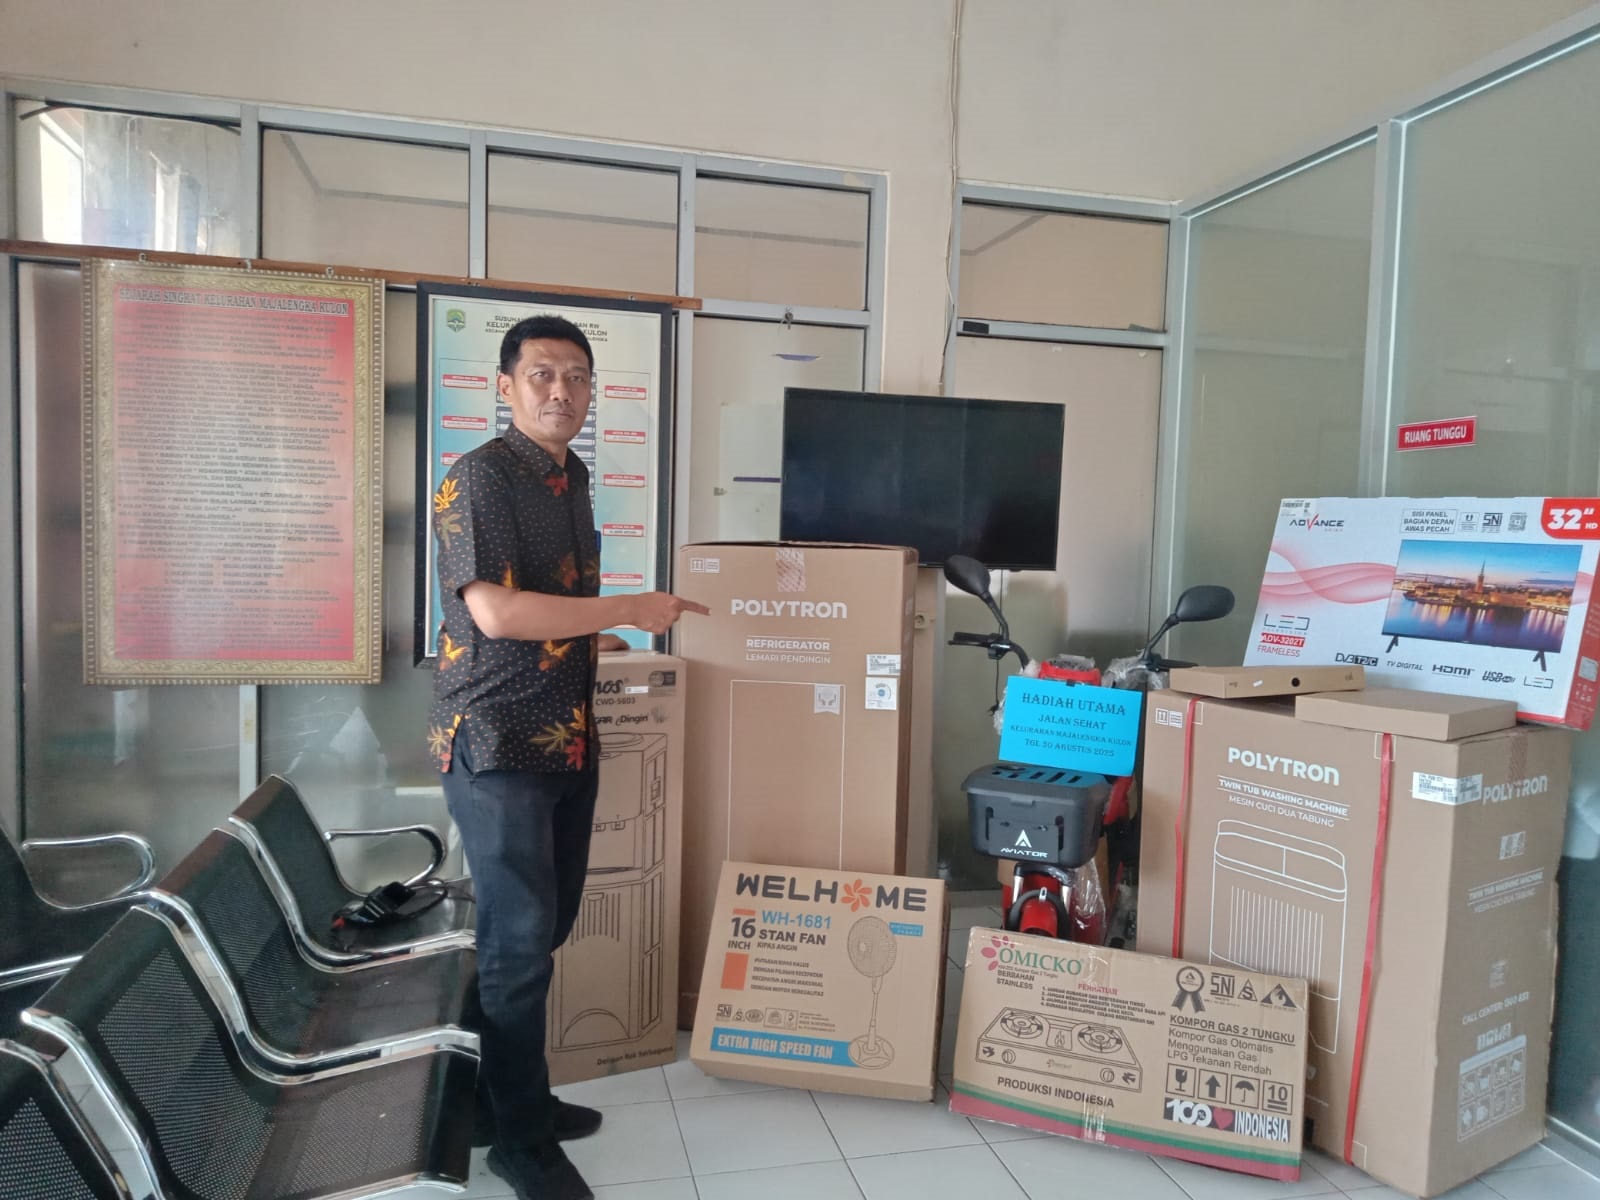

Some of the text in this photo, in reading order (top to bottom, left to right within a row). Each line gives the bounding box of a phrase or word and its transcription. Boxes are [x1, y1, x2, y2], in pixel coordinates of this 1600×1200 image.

[120, 288, 349, 315] SEJARAH SINGKAT KELURAHAN MAJALENGKA KULON
[1404, 426, 1466, 444] RUANG TUNGGU
[1289, 514, 1344, 530] ADVANCE
[1482, 513, 1503, 526] SNI
[730, 599, 848, 619] POLYTRON
[1264, 614, 1310, 630] LED
[746, 639, 830, 650] REFRIGERATOR
[1257, 645, 1301, 658] FRAMELESS
[746, 653, 831, 664] LEMARI PENDINGIN
[1396, 662, 1423, 670] DIGITAL
[1432, 664, 1472, 676] HDMI
[1022, 693, 1126, 716] HADIAH UTAMA
[1038, 714, 1107, 731] JALAN SEHAT
[1010, 725, 1132, 747] KELURAHAN MAJALENGKA KULON
[1025, 738, 1040, 747] TGL
[1055, 742, 1092, 754] AGUSTUS
[1094, 747, 1114, 757] 2025
[1228, 746, 1340, 786] POLYTRON
[1218, 778, 1348, 816] TWIN TUB WASHING MACHINE
[1482, 775, 1548, 805] POLYTRON
[1229, 795, 1335, 828] MESIN CUCI DUA TABUNG
[1000, 847, 1048, 858] AVIATOR
[731, 917, 756, 938] 16
[762, 910, 832, 929] WH-1681
[728, 940, 751, 950] INCH
[759, 929, 826, 945] STAN FAN
[1000, 947, 1082, 976] OMICKO
[997, 970, 1035, 982] BERBAHAN
[997, 978, 1033, 990] STAINLESS
[1210, 974, 1235, 997] SNI
[716, 1004, 732, 1018] SNI
[1170, 1014, 1295, 1044] KOMPOR GAS 2 TUNGKU
[718, 1033, 833, 1059] EXTRA HIGH SPEED FAN
[1169, 1027, 1274, 1054] Kompor Gas Otomatis
[1168, 1039, 1258, 1062] Menggunakan Gas
[1168, 1050, 1272, 1076] LPG Tekanan Rendah
[998, 1077, 1114, 1108] PRODUKSI INDONESIA
[1268, 1085, 1288, 1101] 10
[1234, 1110, 1289, 1143] INDONESIA
